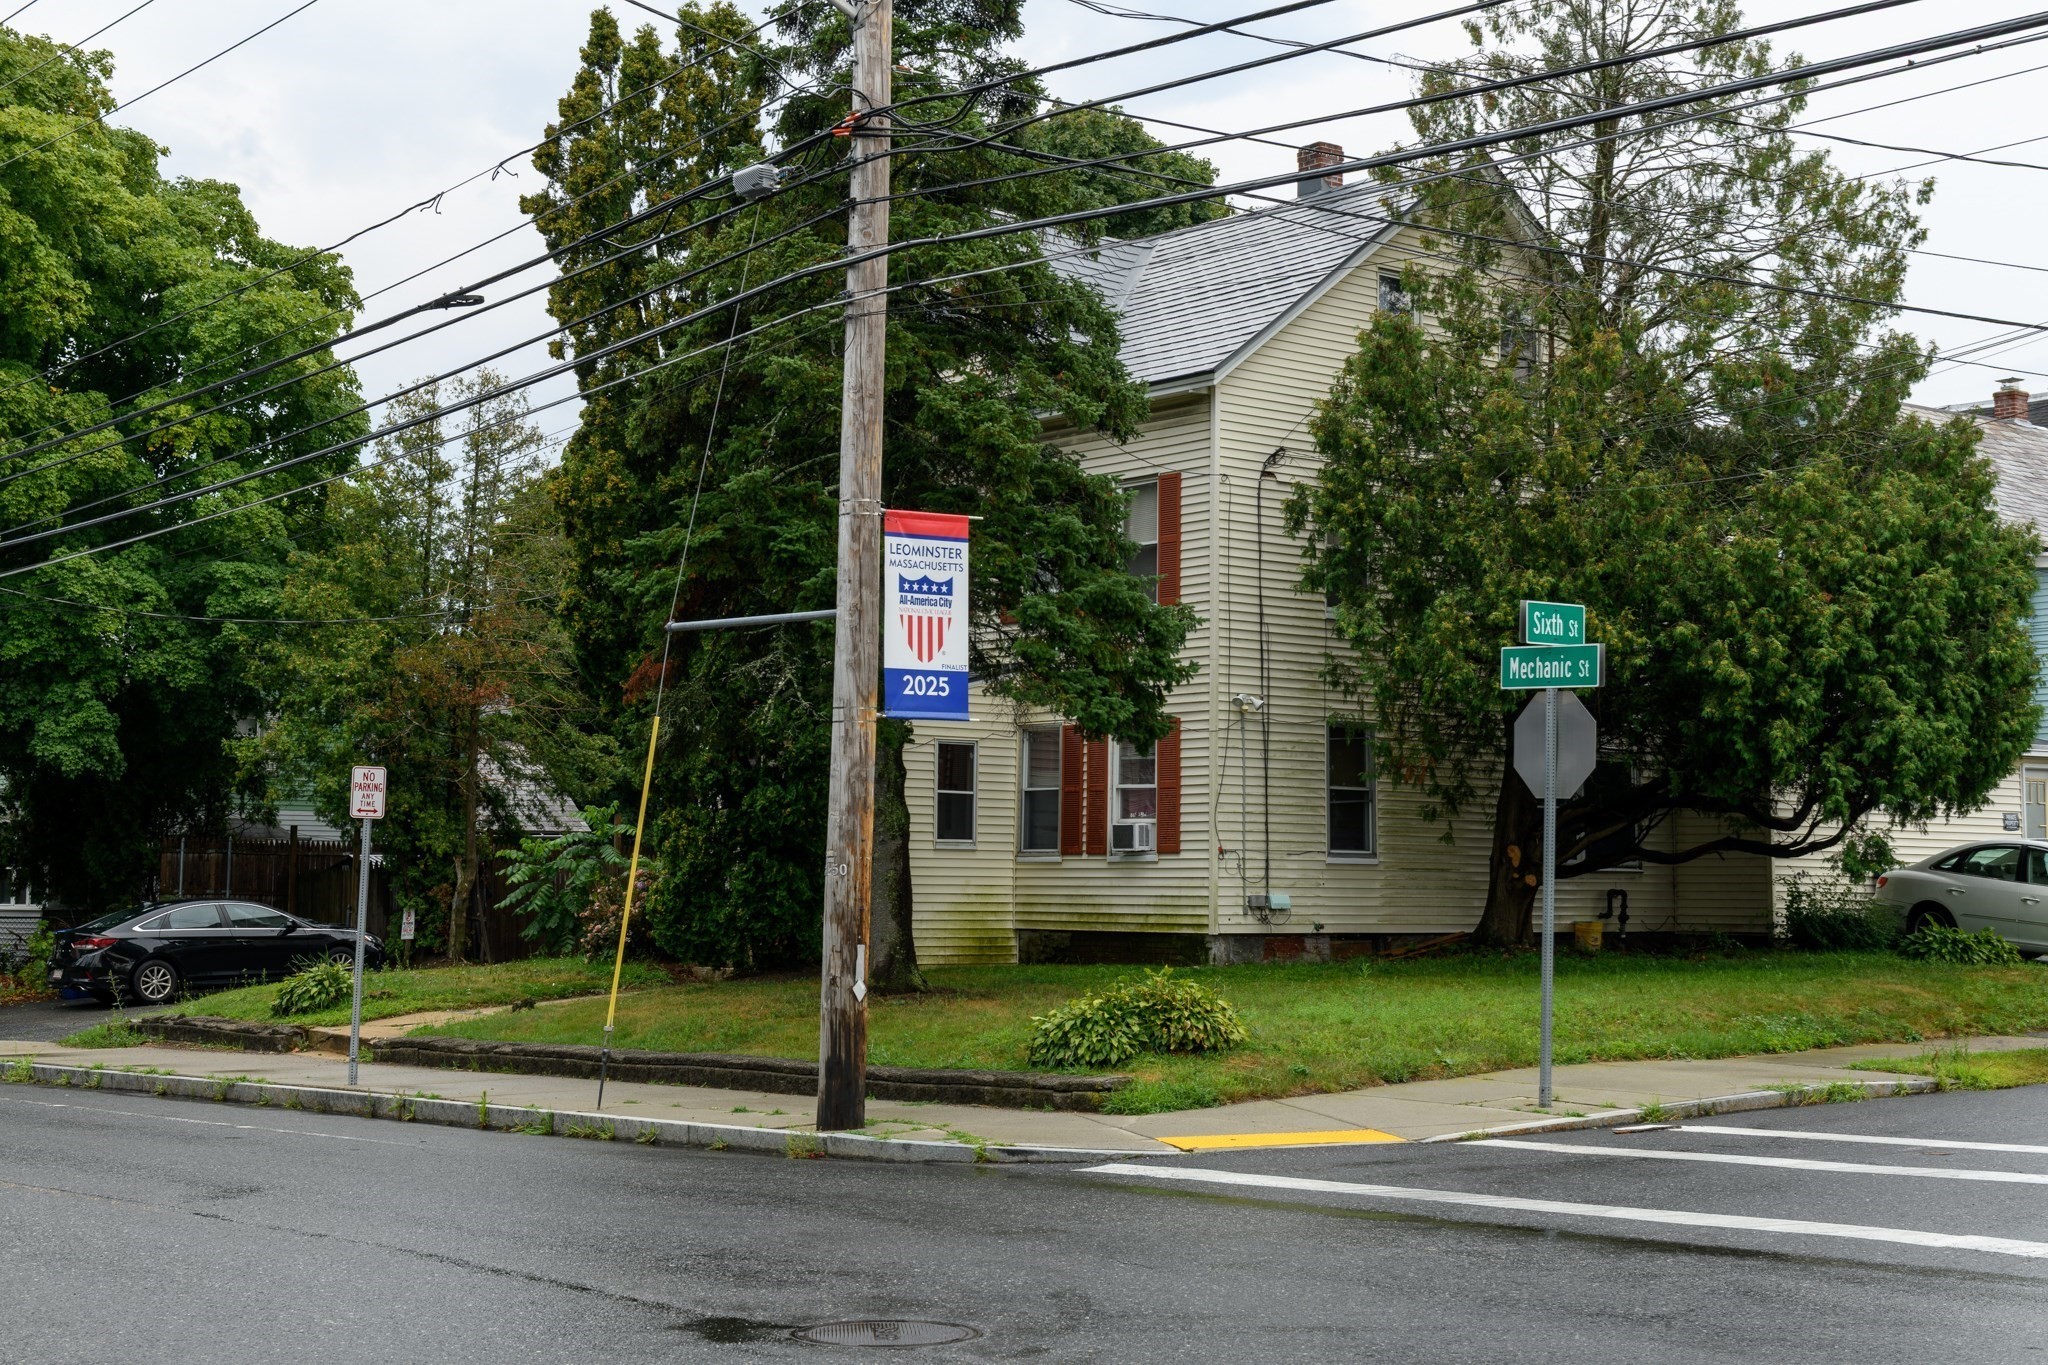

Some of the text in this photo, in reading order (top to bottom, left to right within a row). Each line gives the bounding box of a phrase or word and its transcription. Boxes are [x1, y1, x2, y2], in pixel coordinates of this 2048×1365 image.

[890, 543, 962, 560] LEOMINSTER
[889, 559, 964, 572] MASSACHUSETTS
[899, 594, 952, 609] All-America City
[1533, 611, 1579, 638] Sixth St
[1509, 655, 1590, 679] Mechanic St
[902, 674, 950, 697] 2025
[363, 772, 375, 781] NO
[354, 782, 383, 793] PARKING
